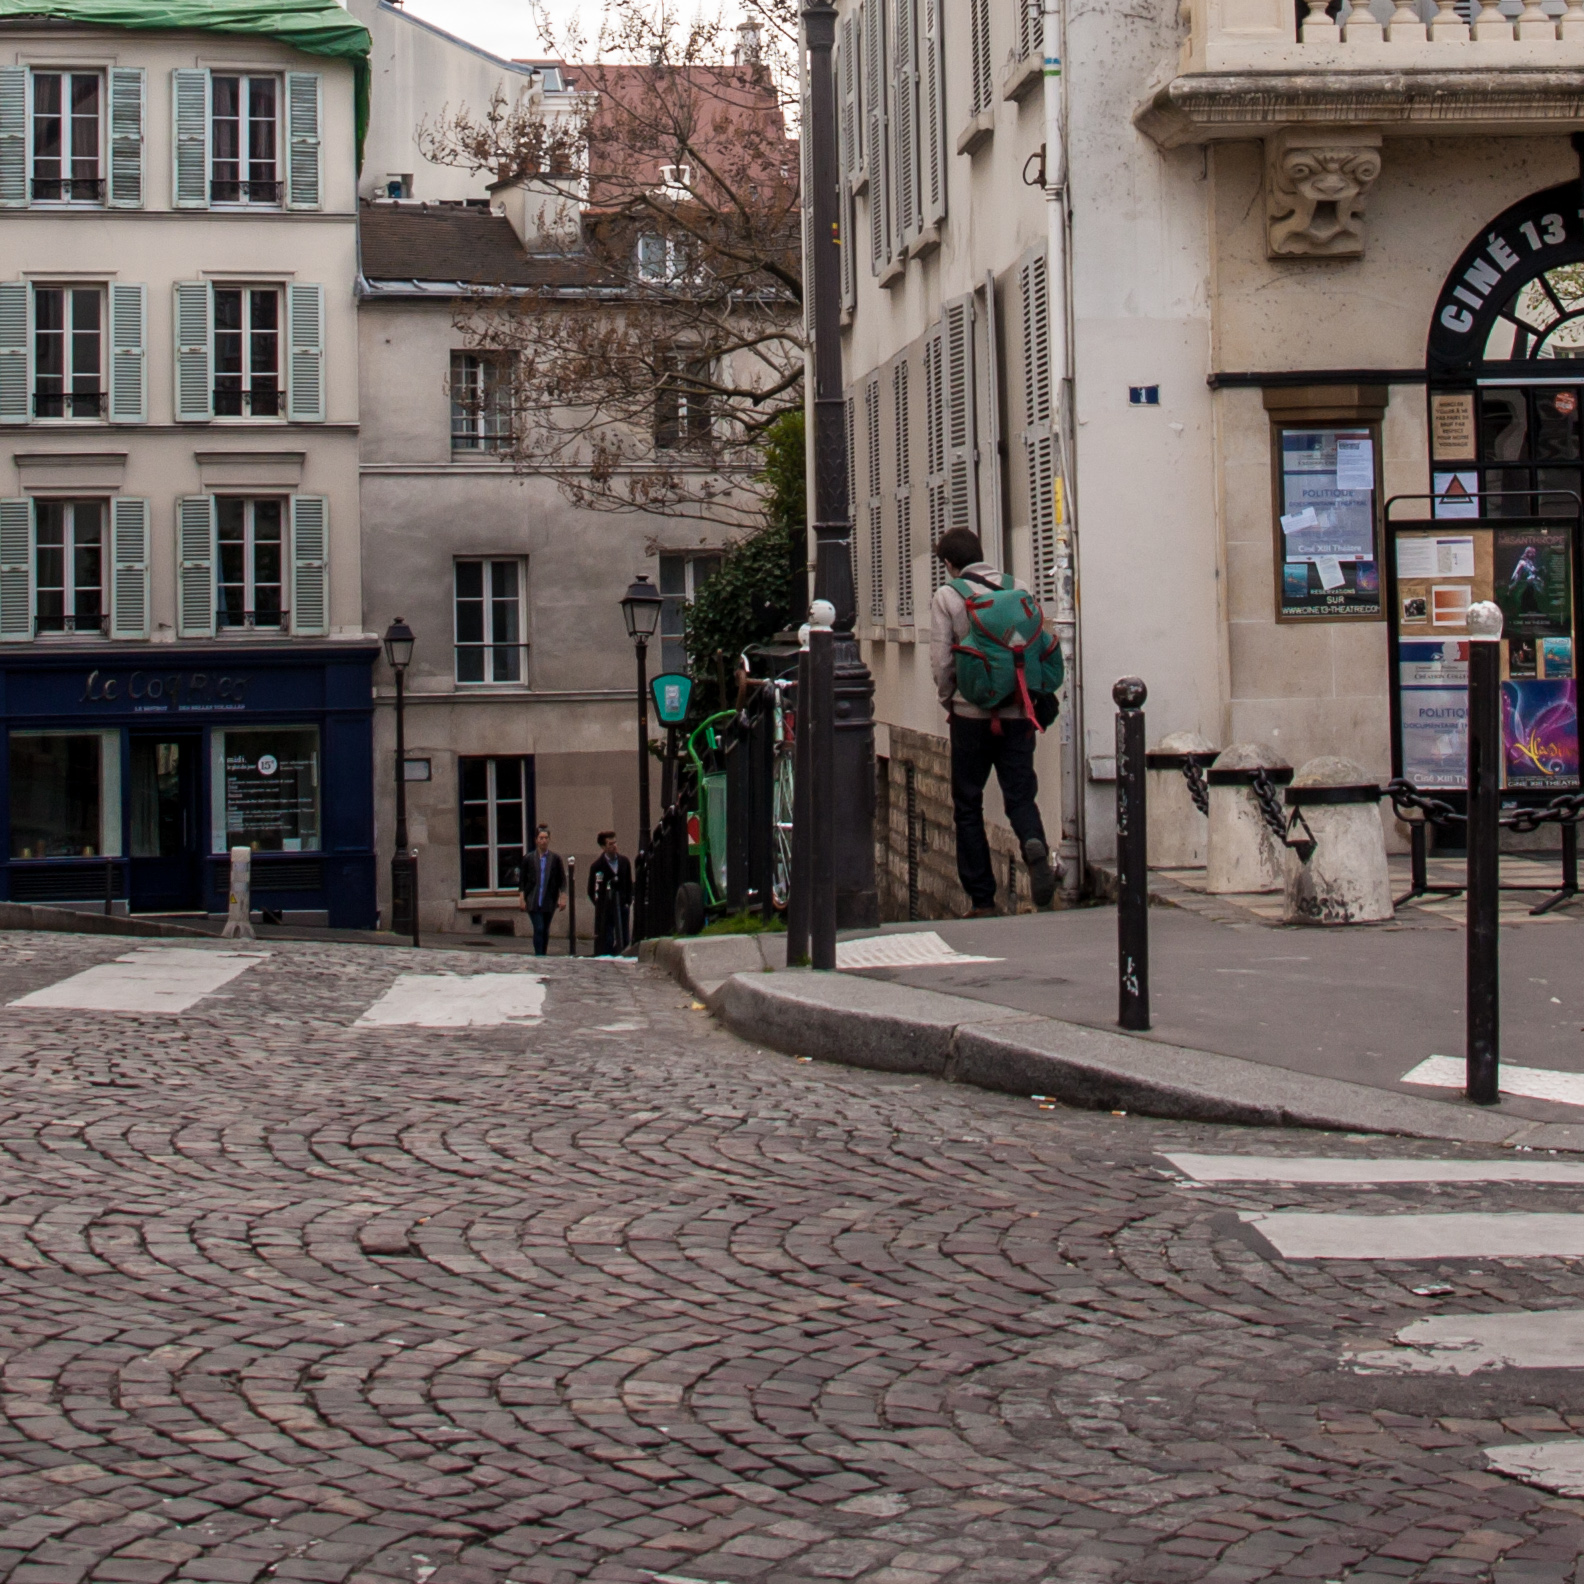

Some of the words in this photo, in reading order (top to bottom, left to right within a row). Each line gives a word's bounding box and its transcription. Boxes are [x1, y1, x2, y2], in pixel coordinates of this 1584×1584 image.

[1440, 233, 1521, 333] CINÉ
[1519, 213, 1567, 252] 13
[1137, 387, 1147, 403] 1
[1302, 489, 1354, 498] POLITIQUE
[1498, 535, 1565, 545] MISANTHROPE
[1326, 595, 1345, 604] SUR
[79, 669, 118, 702] Le
[1418, 707, 1469, 718] POLITIQ
